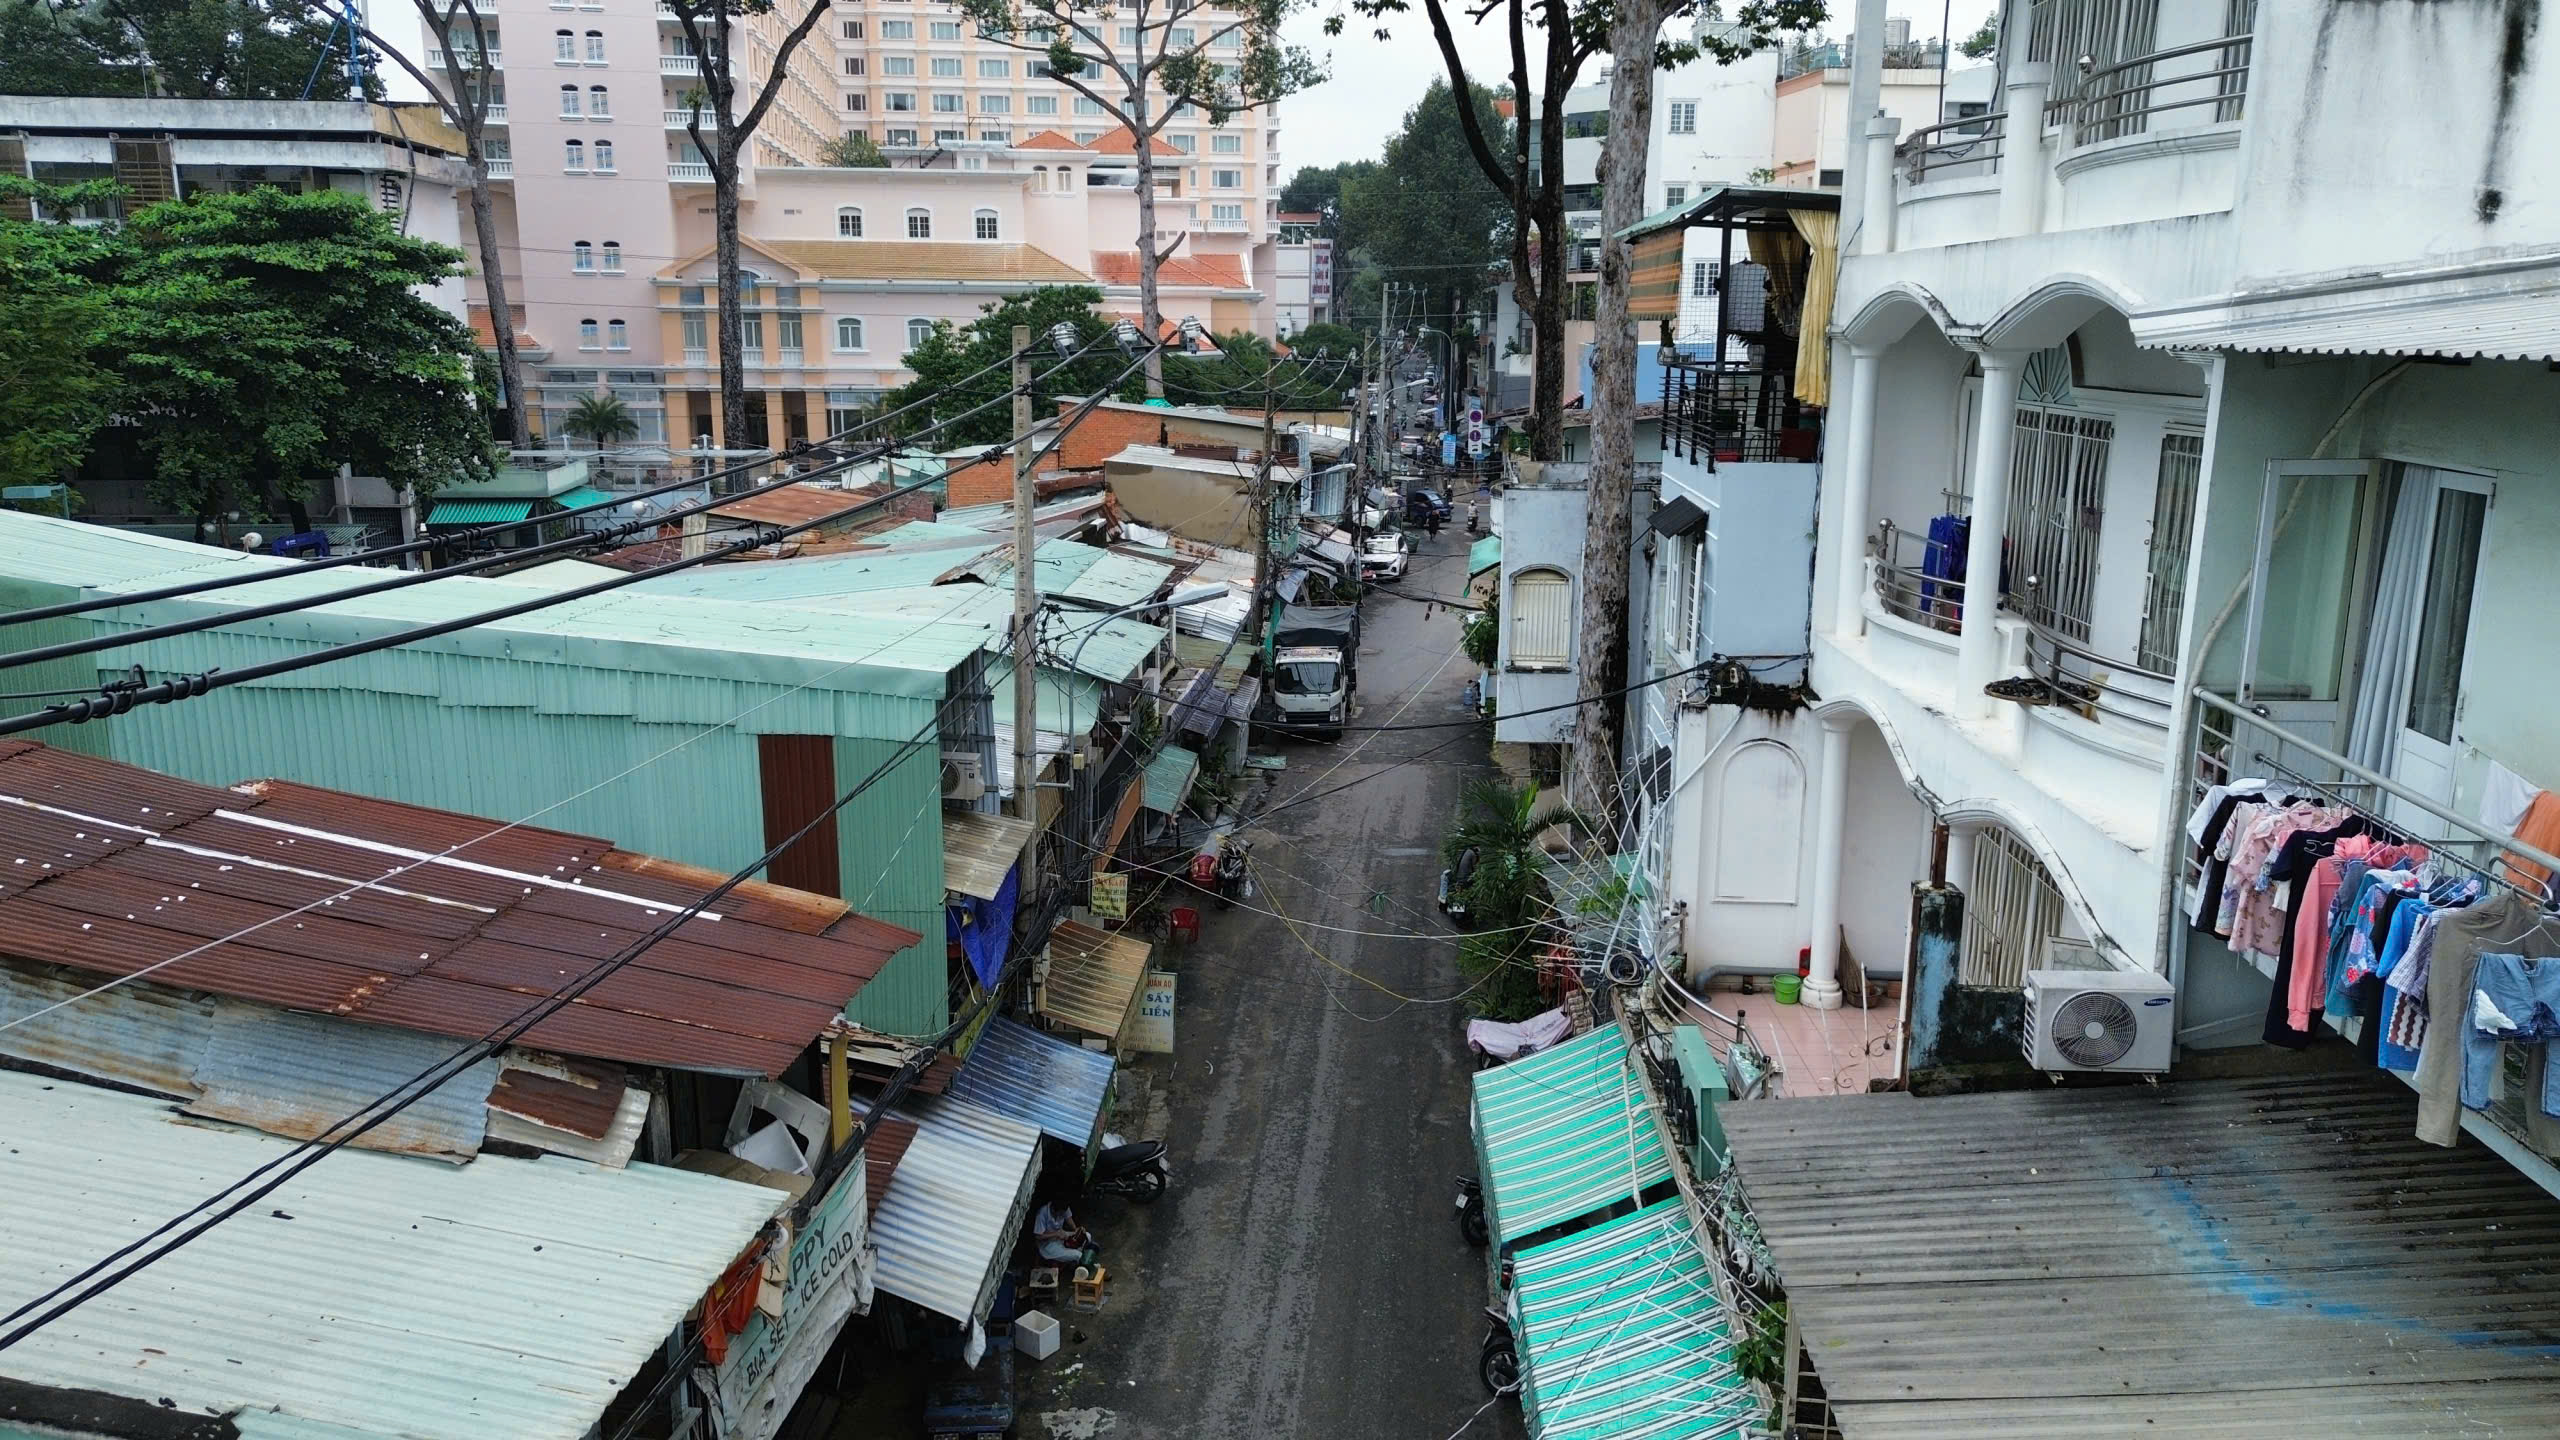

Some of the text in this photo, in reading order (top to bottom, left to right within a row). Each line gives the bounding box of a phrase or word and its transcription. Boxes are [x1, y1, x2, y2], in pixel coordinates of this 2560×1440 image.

[746, 1347, 767, 1387] BIA
[800, 1273, 819, 1309] ICE
[820, 1231, 854, 1279] COLD
